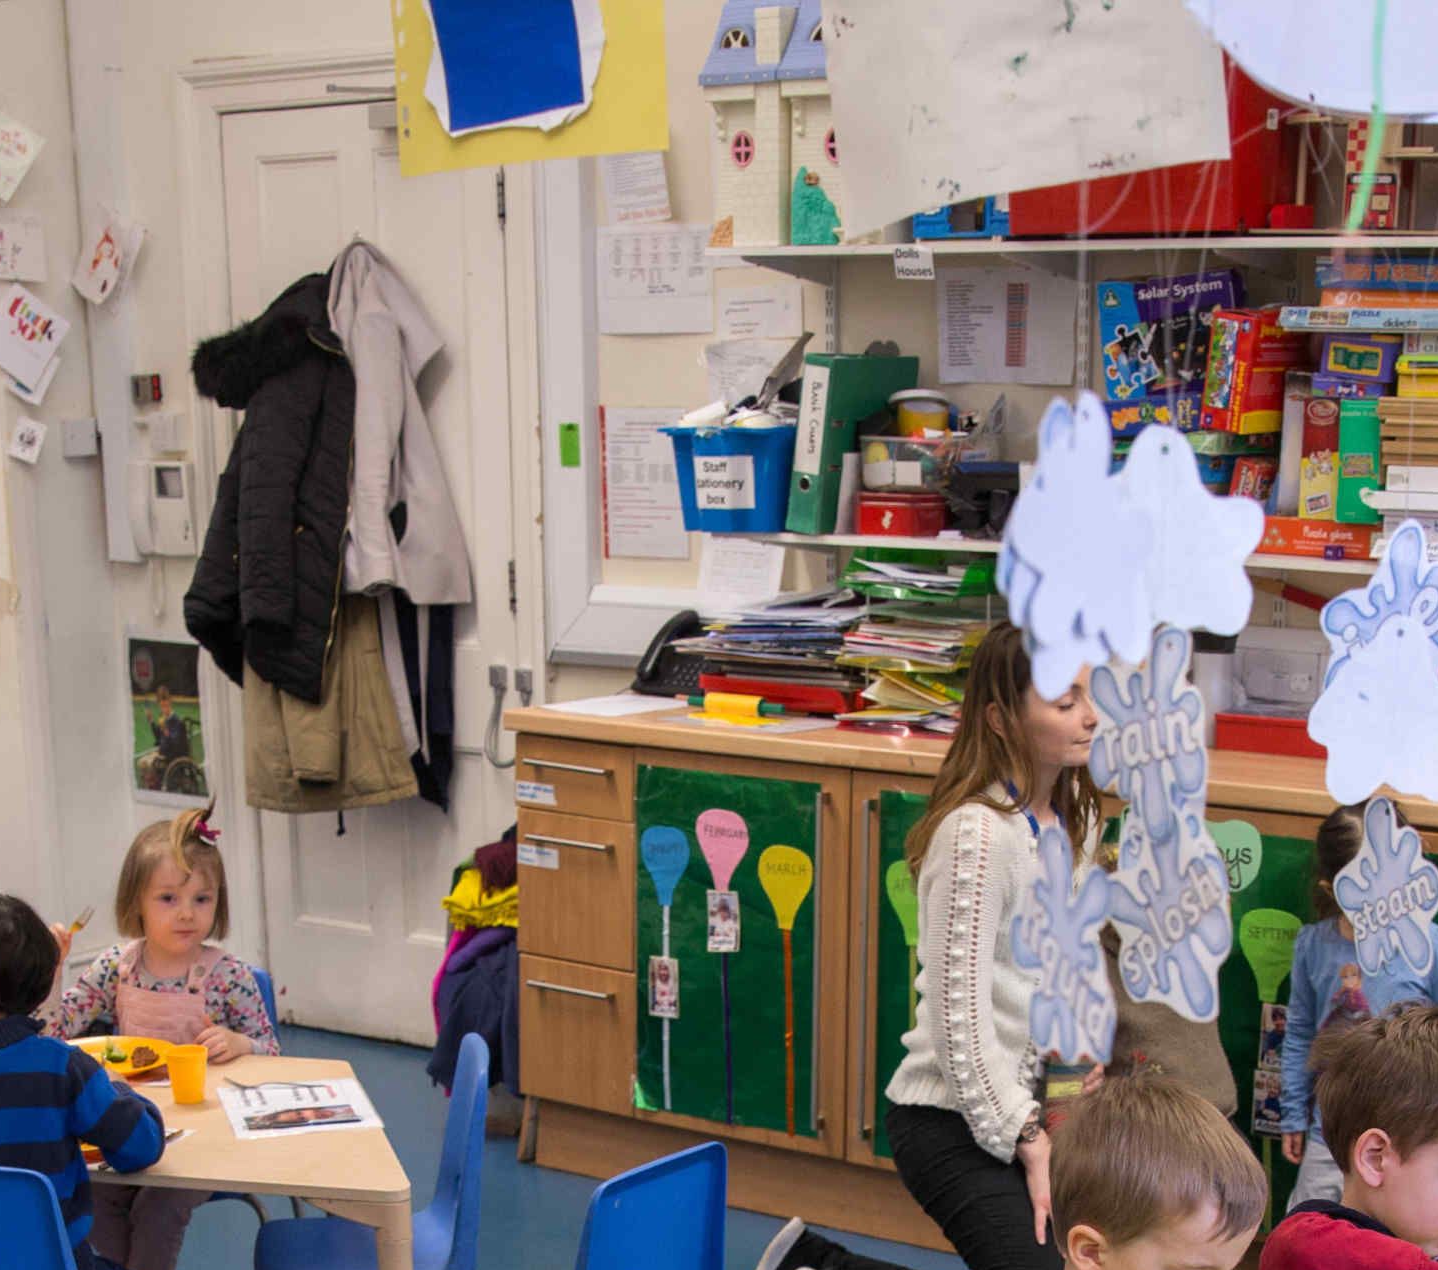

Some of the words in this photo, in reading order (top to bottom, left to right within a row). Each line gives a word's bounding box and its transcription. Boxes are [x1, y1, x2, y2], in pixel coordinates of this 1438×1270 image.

[895, 248, 920, 259] Dolls
[896, 266, 933, 277] Houses
[1137, 284, 1171, 301] Solar
[1172, 278, 1223, 298] System
[811, 381, 824, 412] BLANK
[702, 461, 728, 473] Staff
[706, 494, 726, 505] box
[1103, 699, 1199, 774] rain
[764, 862, 809, 877] MARCH
[1353, 874, 1437, 943] steam
[1121, 862, 1225, 990] splosh
